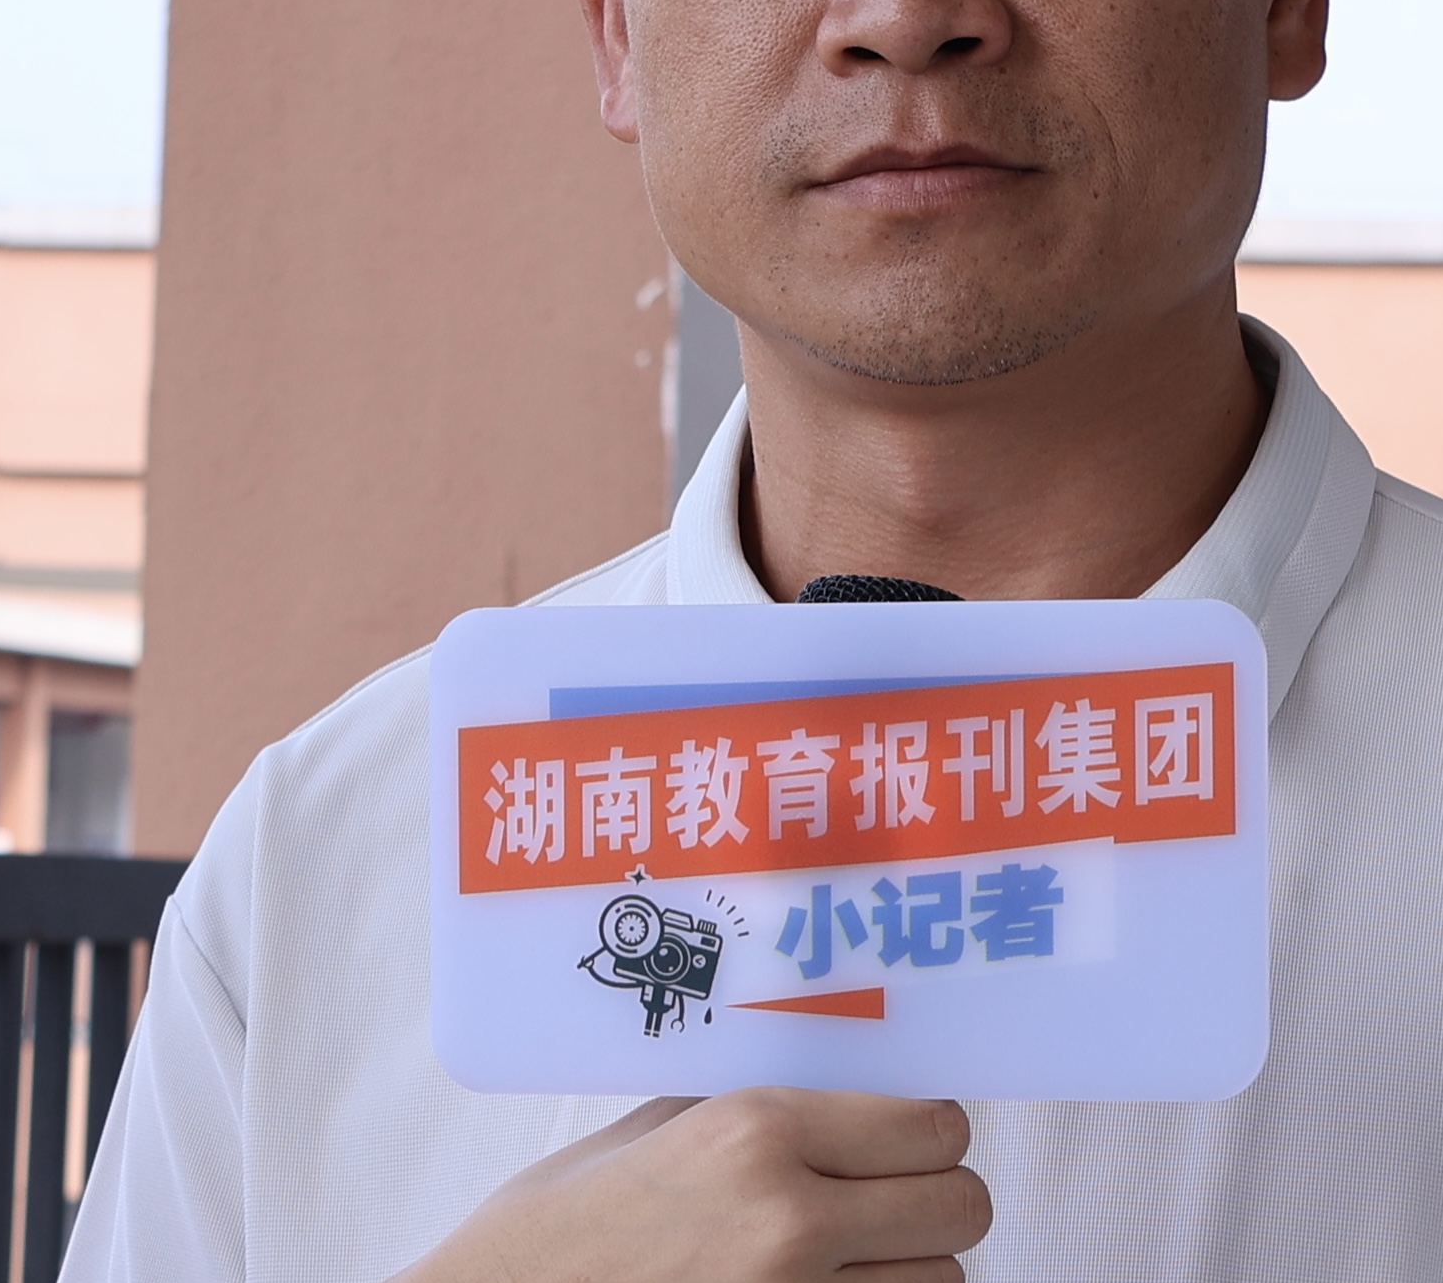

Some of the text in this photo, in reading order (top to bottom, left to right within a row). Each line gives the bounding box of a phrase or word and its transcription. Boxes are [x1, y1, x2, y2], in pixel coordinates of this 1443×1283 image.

[484, 691, 1215, 866] 湖南教育报刊集团
[774, 862, 1064, 980] 小记者
